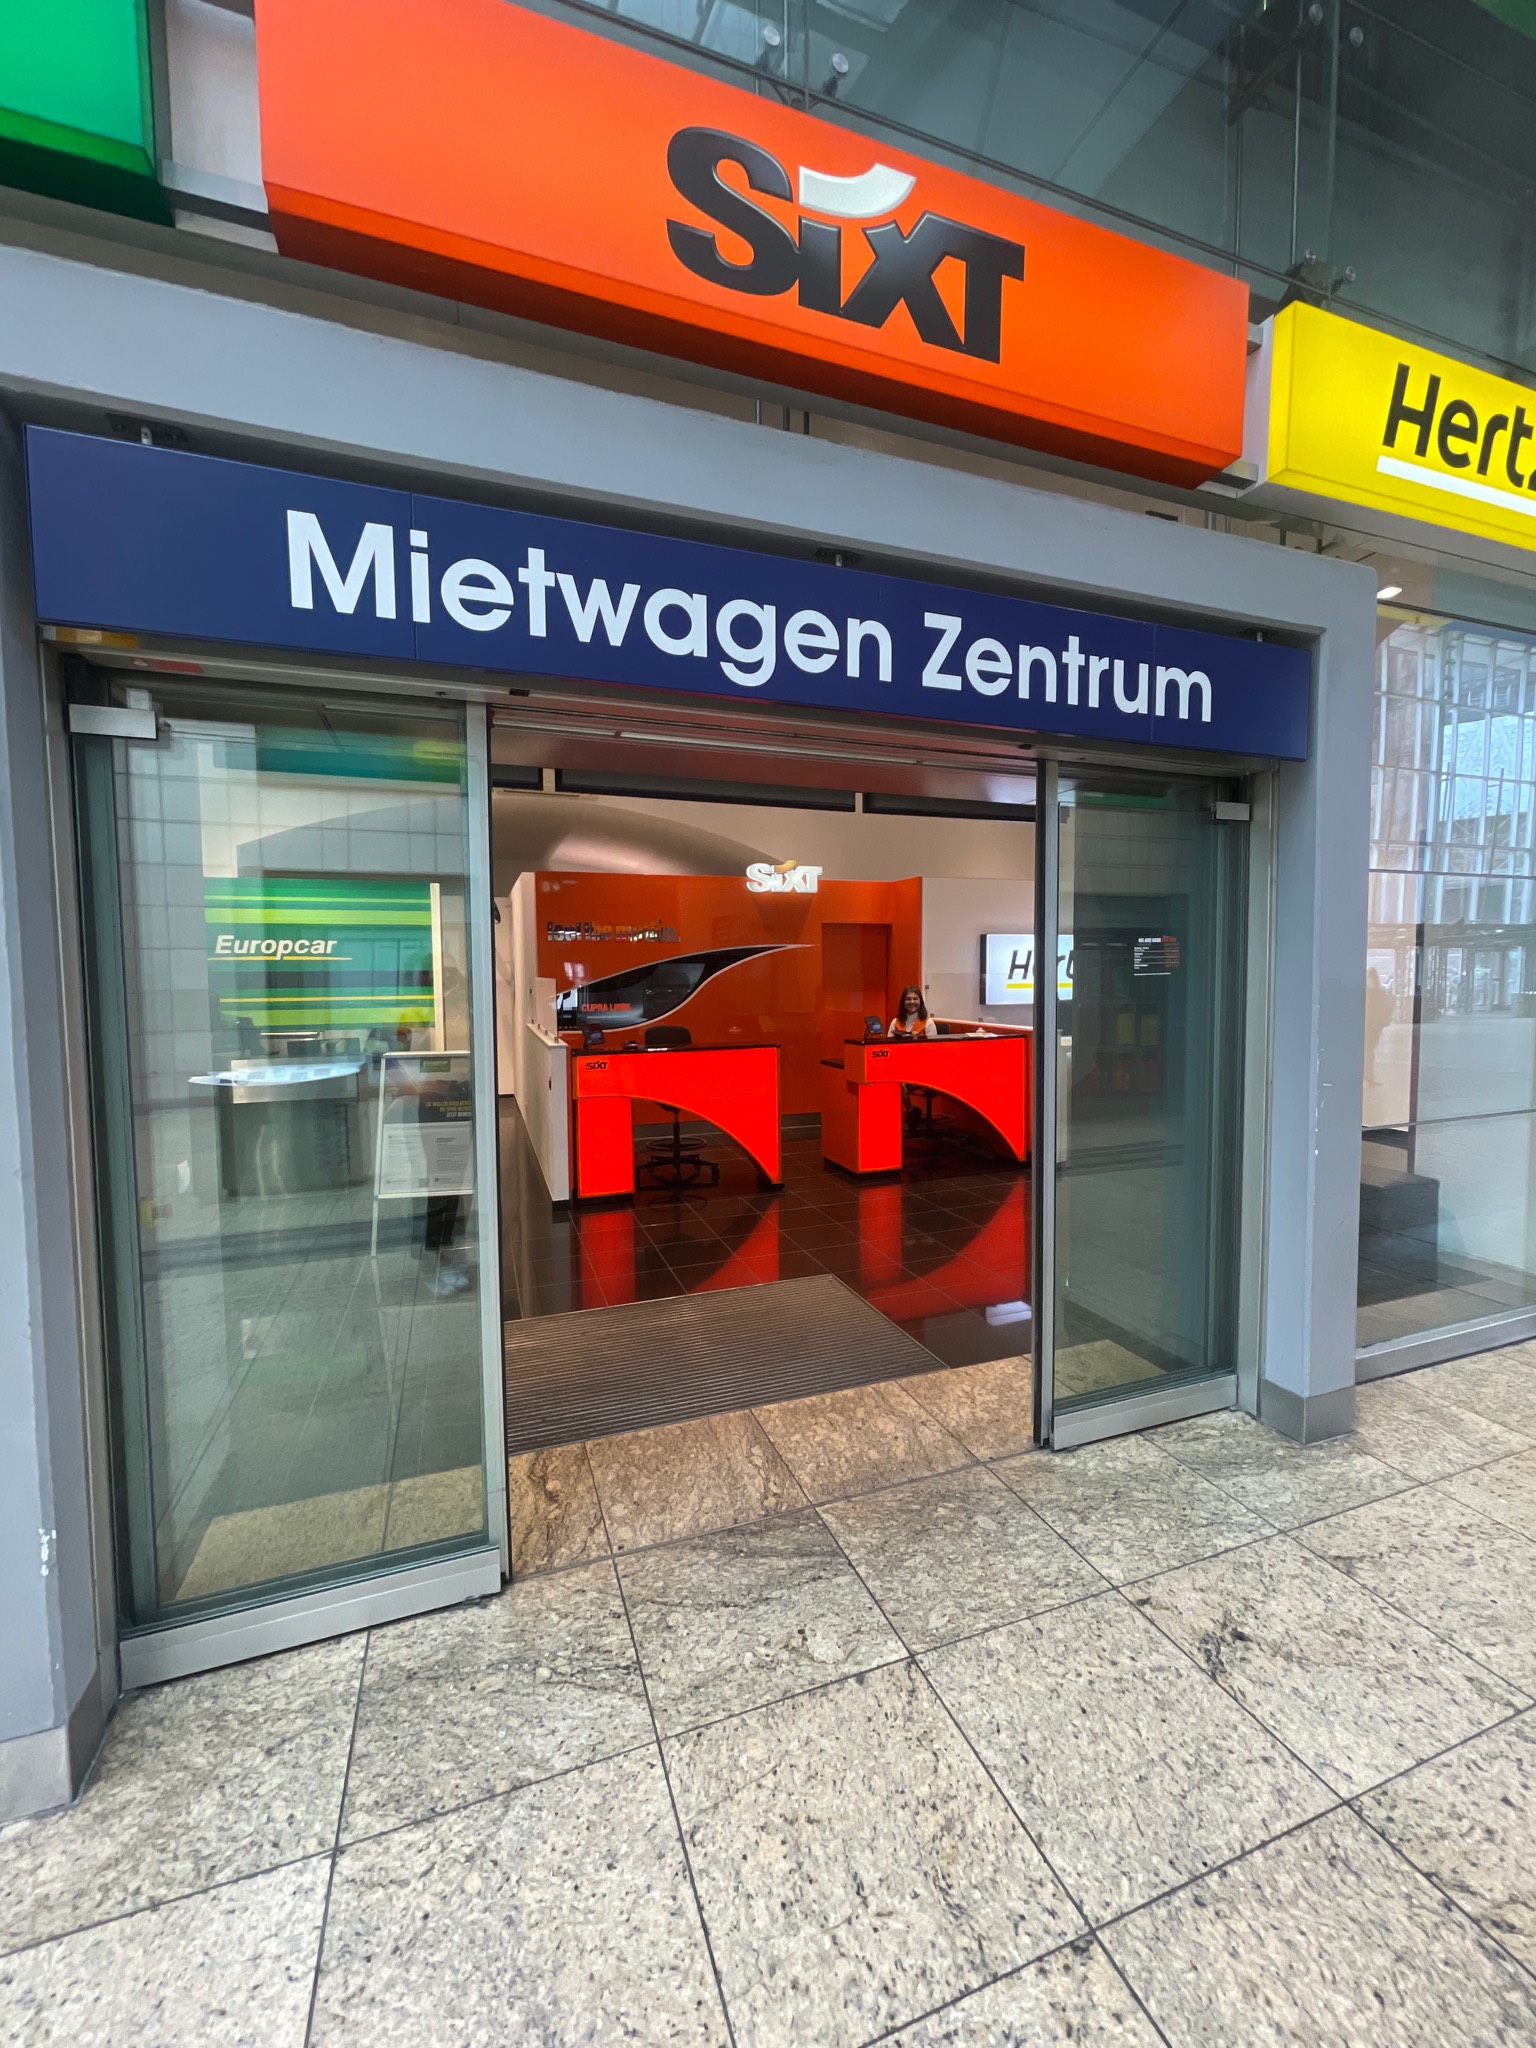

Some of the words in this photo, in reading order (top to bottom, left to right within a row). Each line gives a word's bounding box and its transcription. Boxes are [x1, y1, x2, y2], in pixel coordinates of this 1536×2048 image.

[286, 509, 892, 687] Mietwagen
[922, 611, 1212, 723] Zentrum
[215, 934, 338, 961] Europcar
